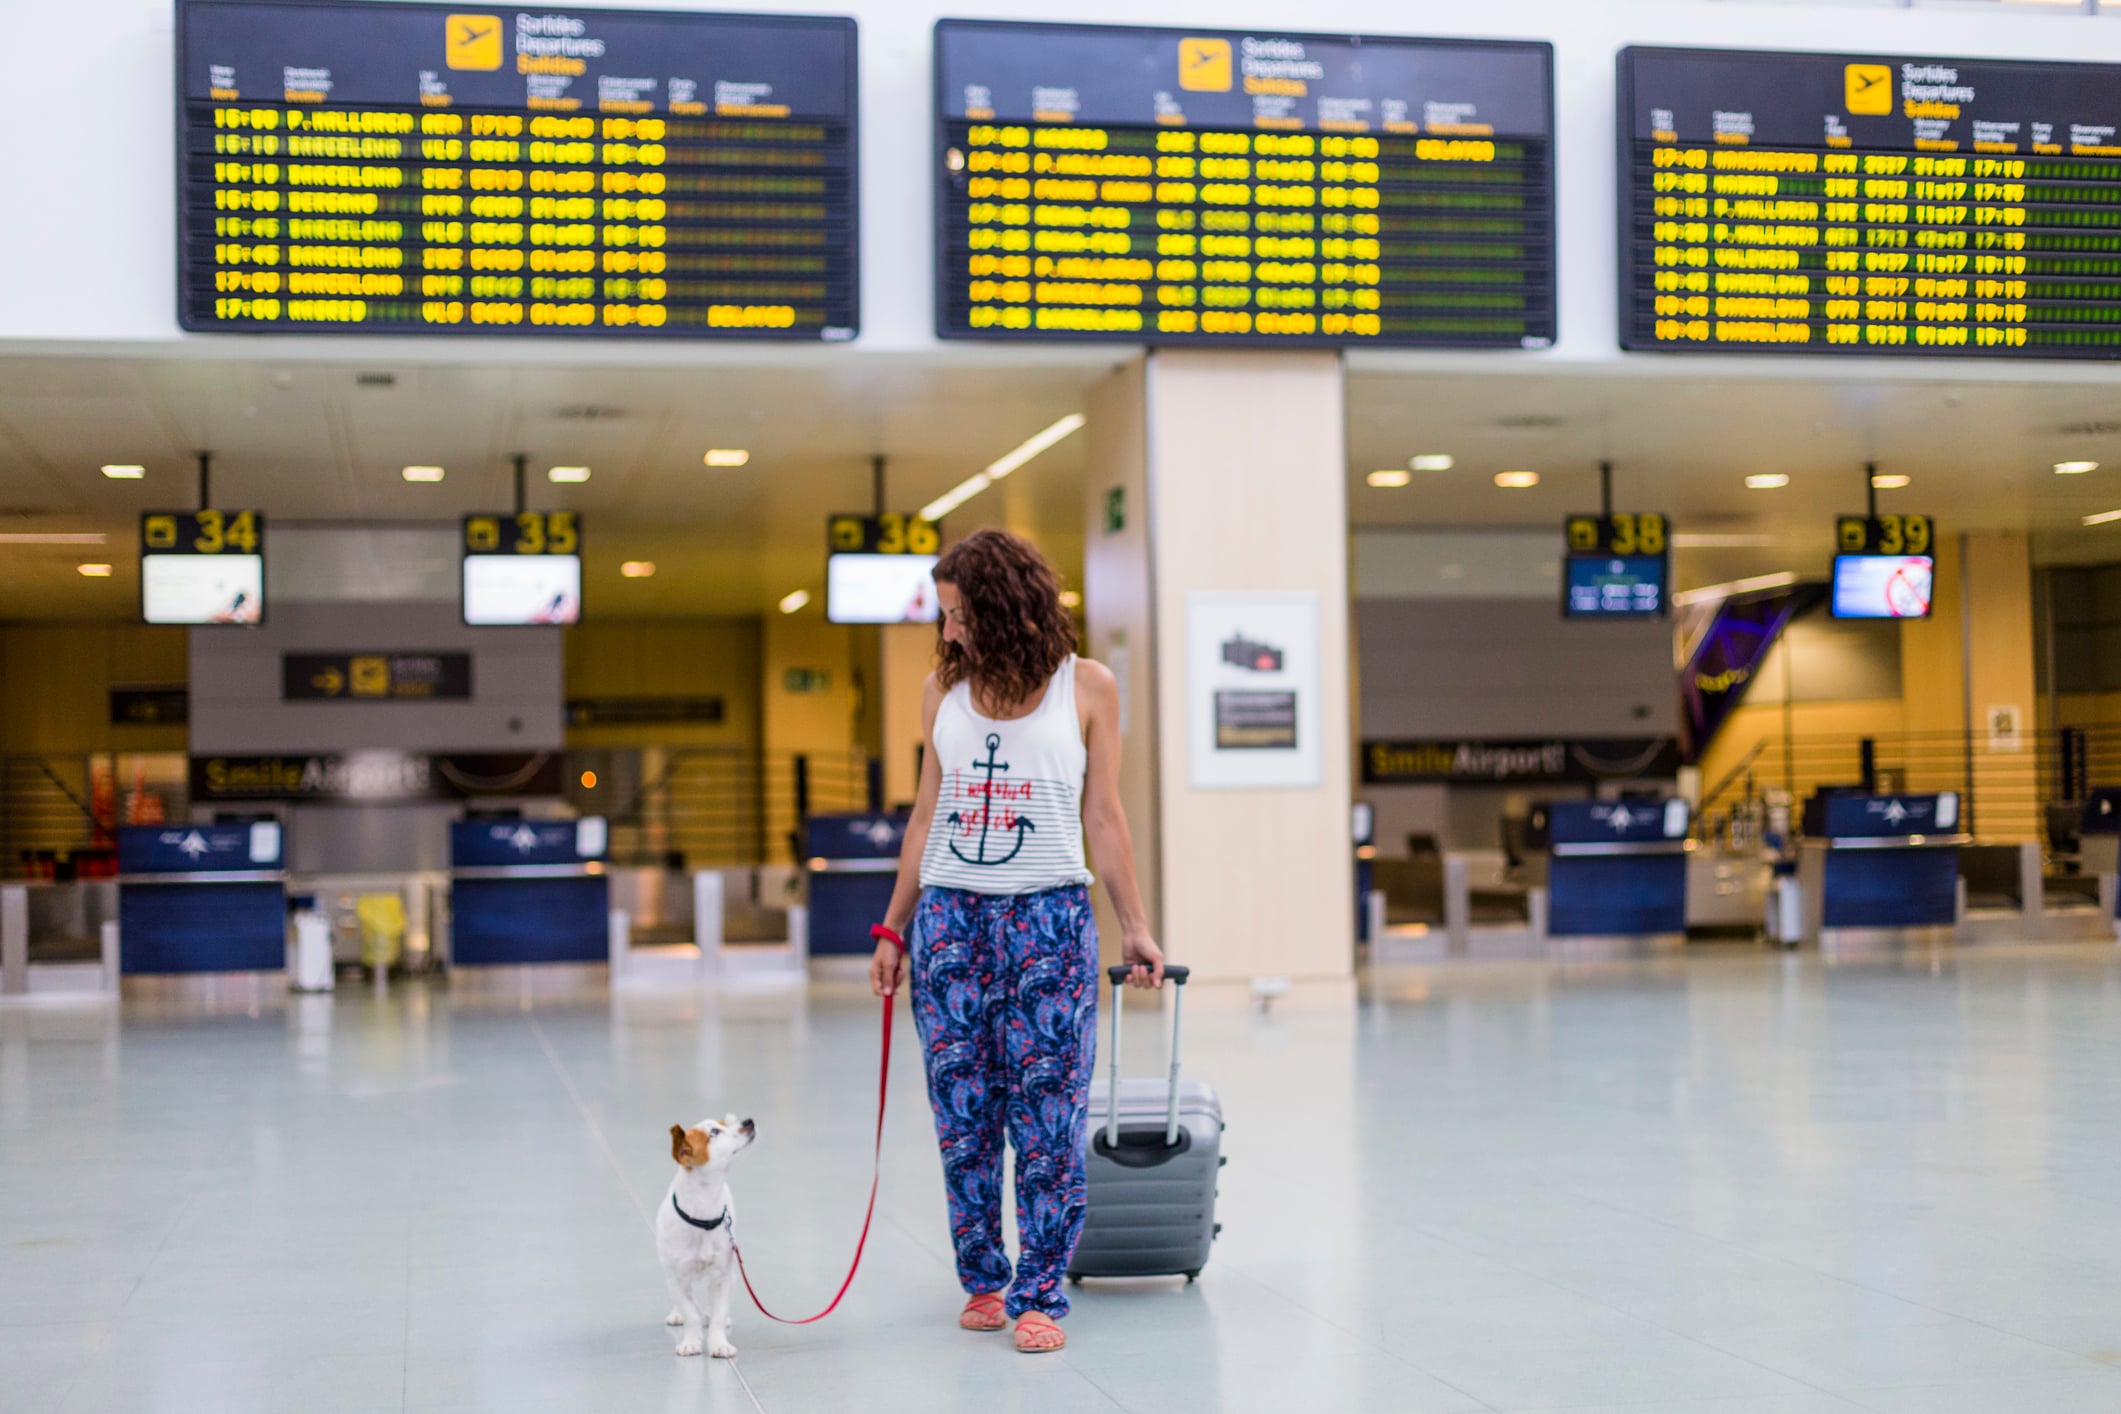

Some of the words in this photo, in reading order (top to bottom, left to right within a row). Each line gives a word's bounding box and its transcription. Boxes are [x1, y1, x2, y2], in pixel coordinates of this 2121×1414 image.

[516, 13, 585, 36] Sortides
[516, 33, 605, 57] Departures
[518, 53, 587, 76] Salidas
[1901, 63, 1958, 84] Sortides
[1901, 81, 1975, 102] Departures
[194, 510, 257, 553] 34
[515, 512, 577, 554] 35
[877, 512, 939, 554] 36
[1611, 514, 1664, 555] 38
[1879, 514, 1930, 554] 39
